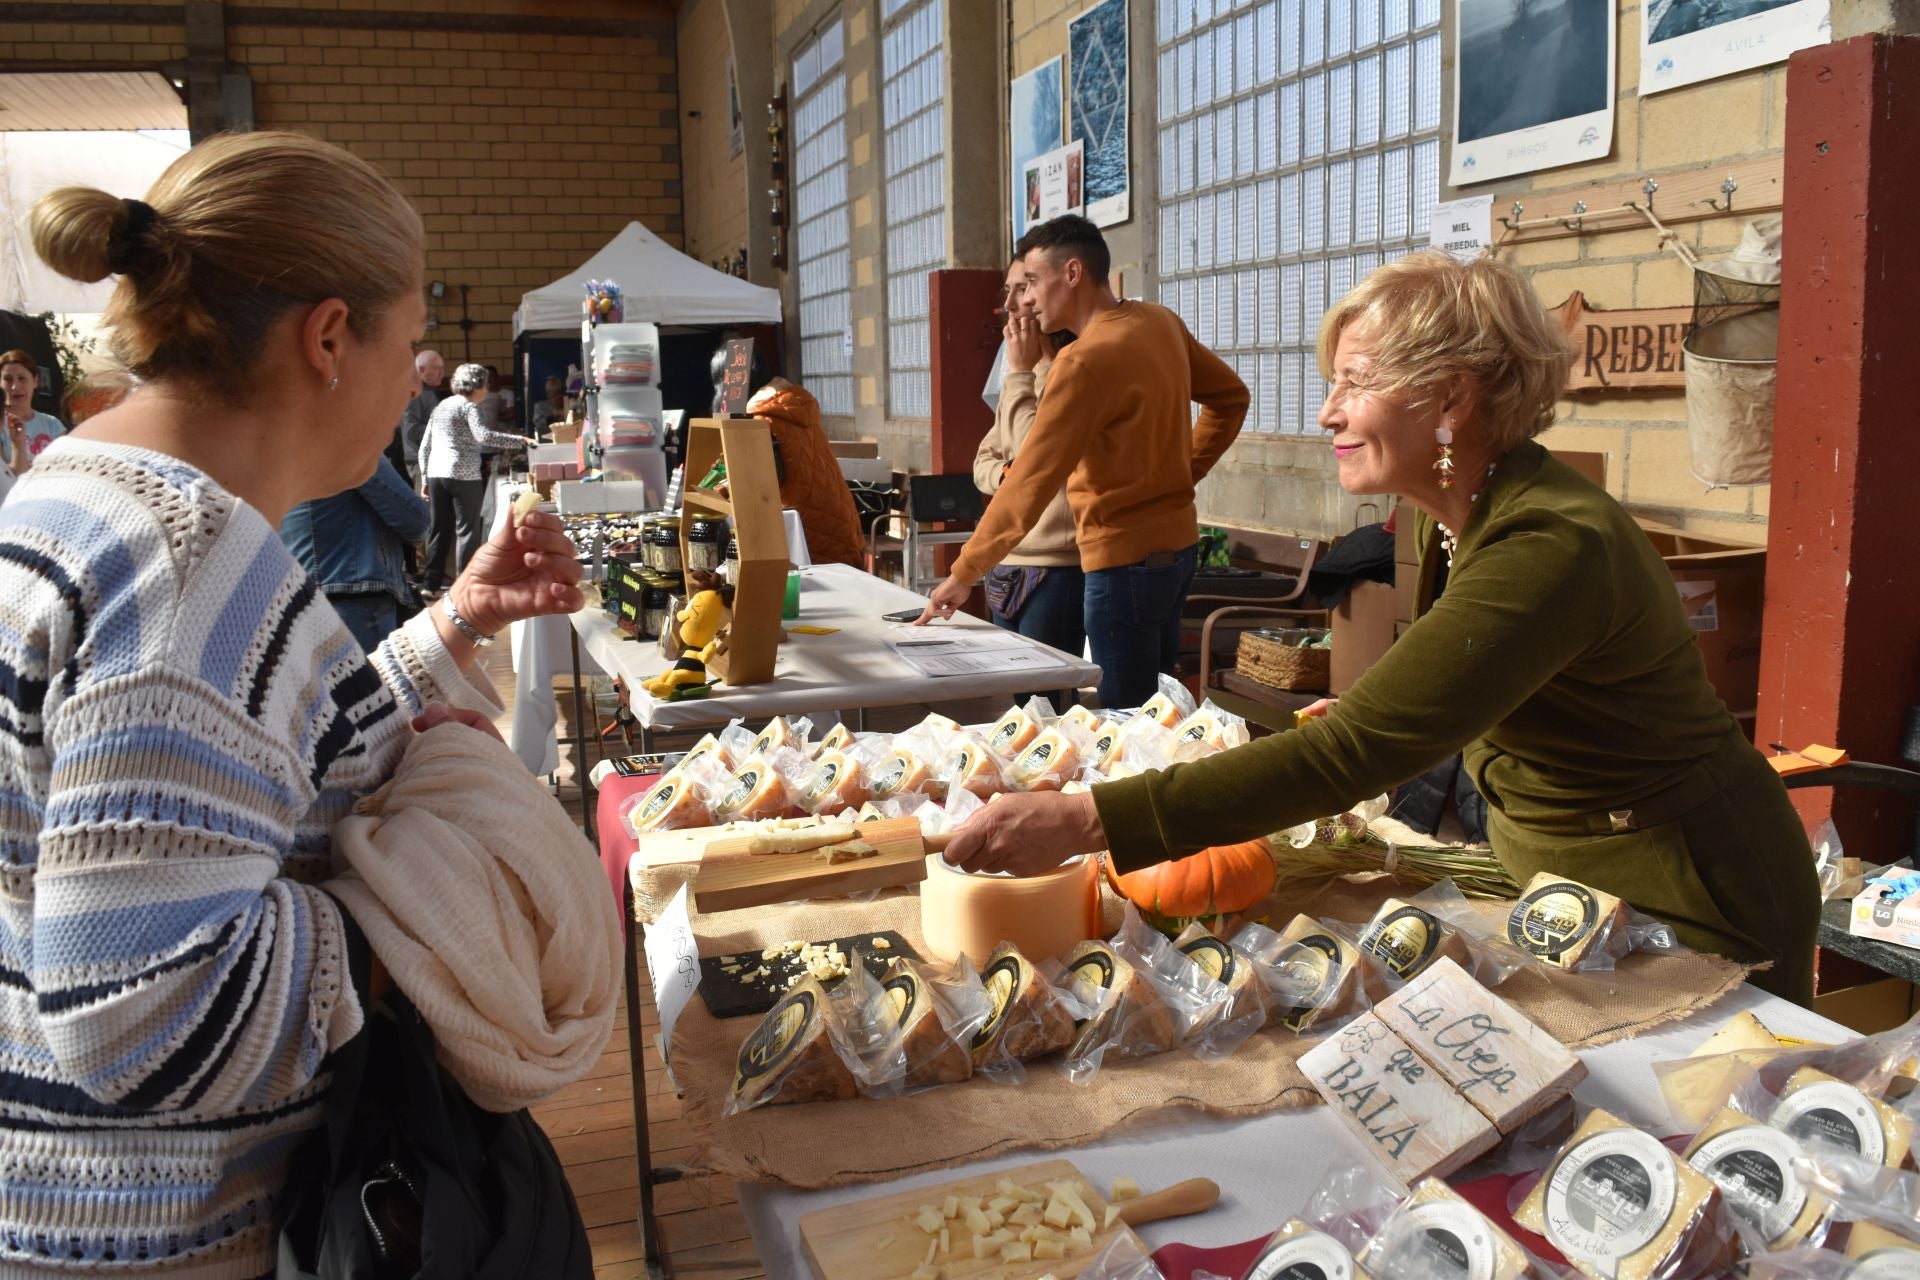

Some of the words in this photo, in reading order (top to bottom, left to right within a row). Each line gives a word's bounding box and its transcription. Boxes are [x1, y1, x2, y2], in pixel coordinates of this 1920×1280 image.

[1506, 141, 1549, 160] BURGOS
[1452, 222, 1471, 233] MIEL
[1583, 322, 1697, 386] REBE
[1876, 909, 1891, 919] LG
[1382, 1048, 1425, 1085] que
[1321, 1055, 1421, 1161] BALA
